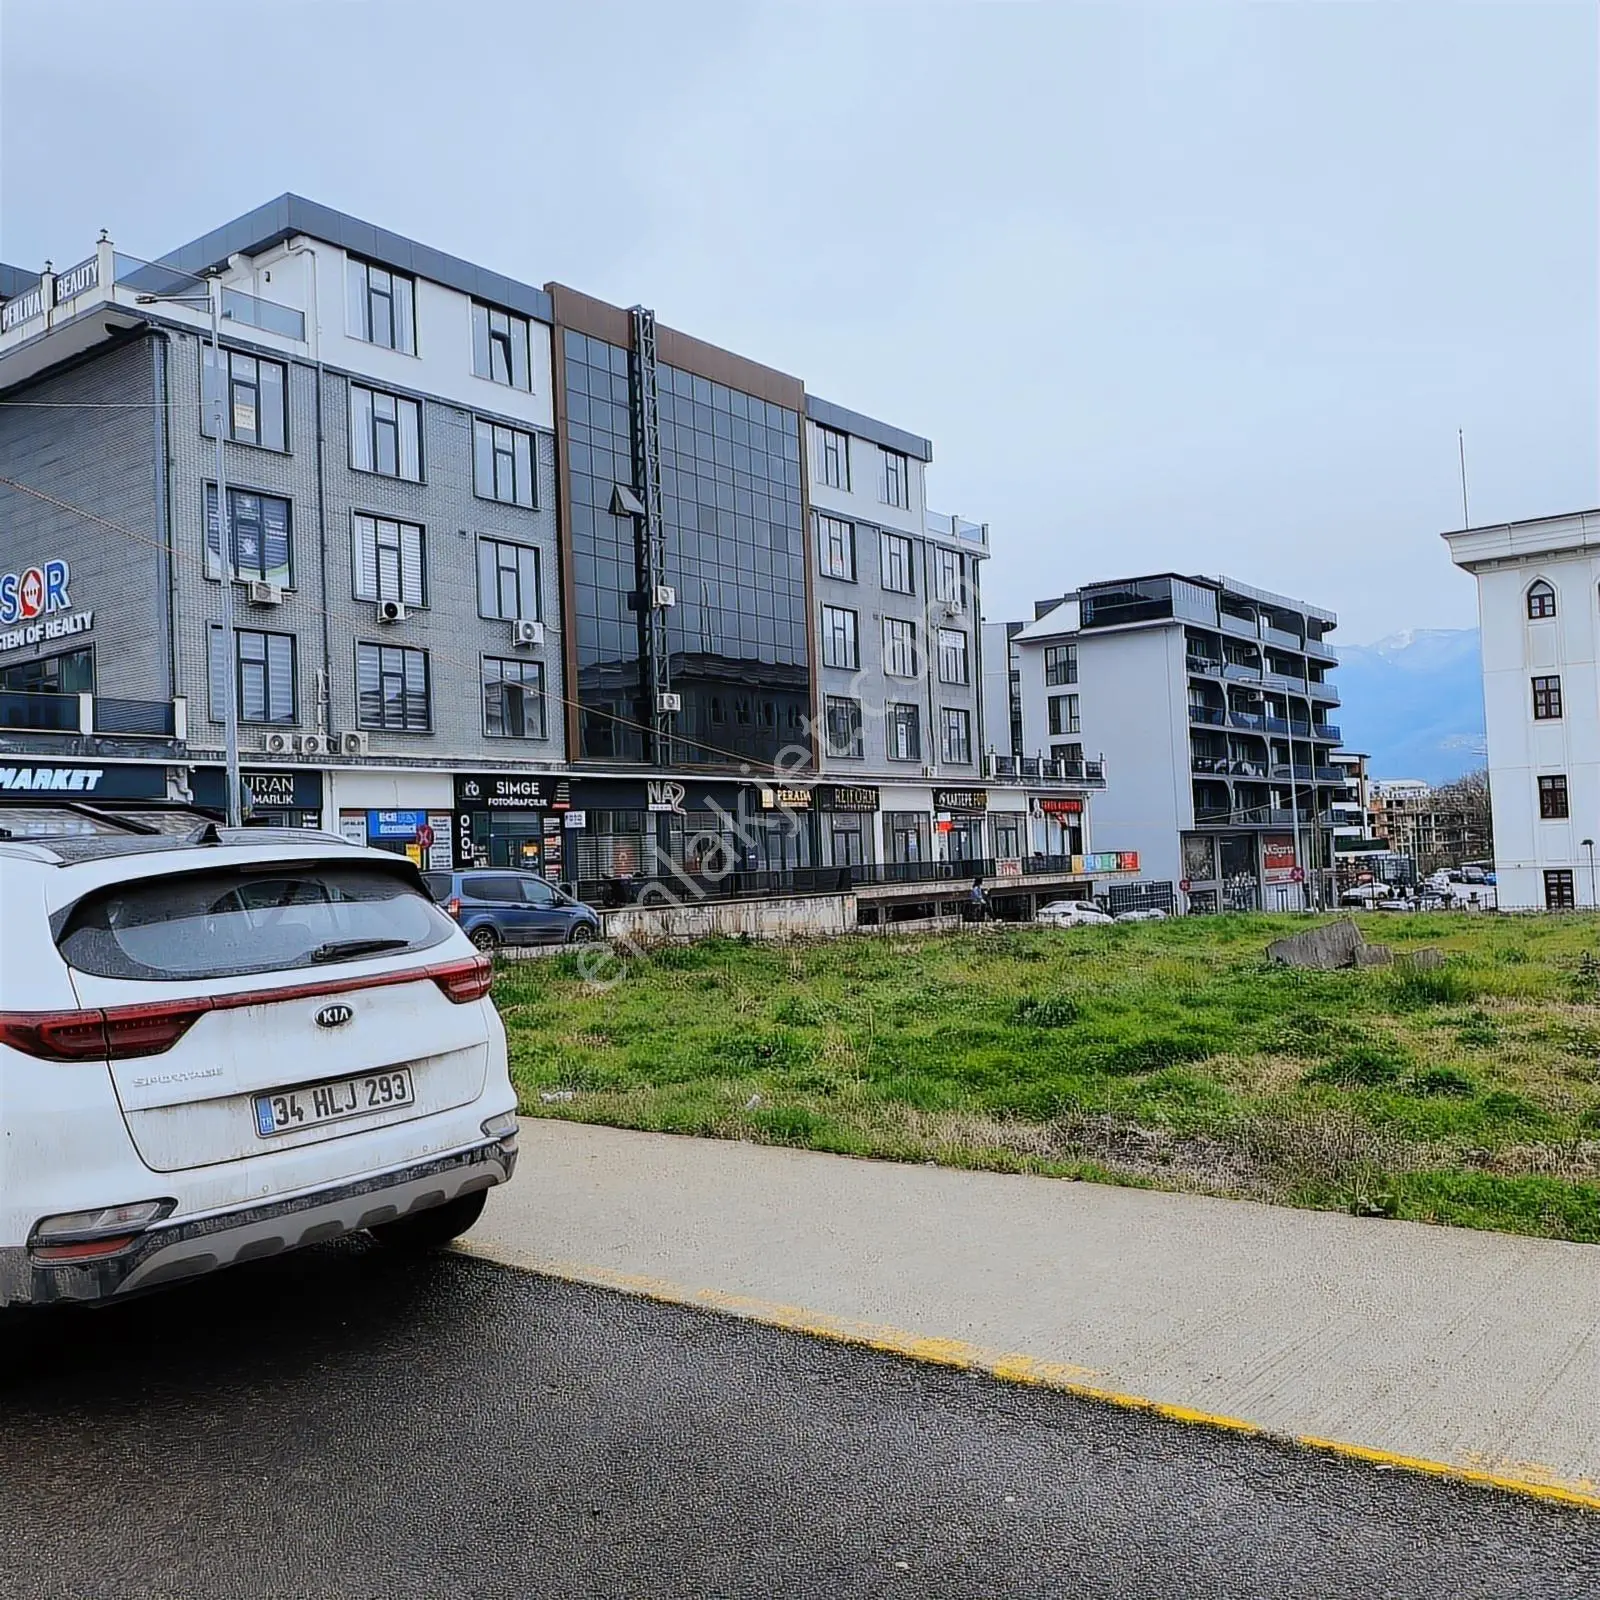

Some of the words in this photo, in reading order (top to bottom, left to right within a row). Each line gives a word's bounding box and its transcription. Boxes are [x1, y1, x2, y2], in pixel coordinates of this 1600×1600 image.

[57, 260, 98, 303] BEAUTY
[26, 624, 44, 644] OF
[45, 611, 93, 640] REALTY
[0, 767, 103, 790] MARKET
[777, 788, 812, 802] PERADA
[460, 815, 471, 860] FOTO
[322, 1008, 350, 1024] KIA
[273, 1095, 304, 1126] 34
[313, 1089, 358, 1118] HLJ
[365, 1073, 407, 1106] 293
